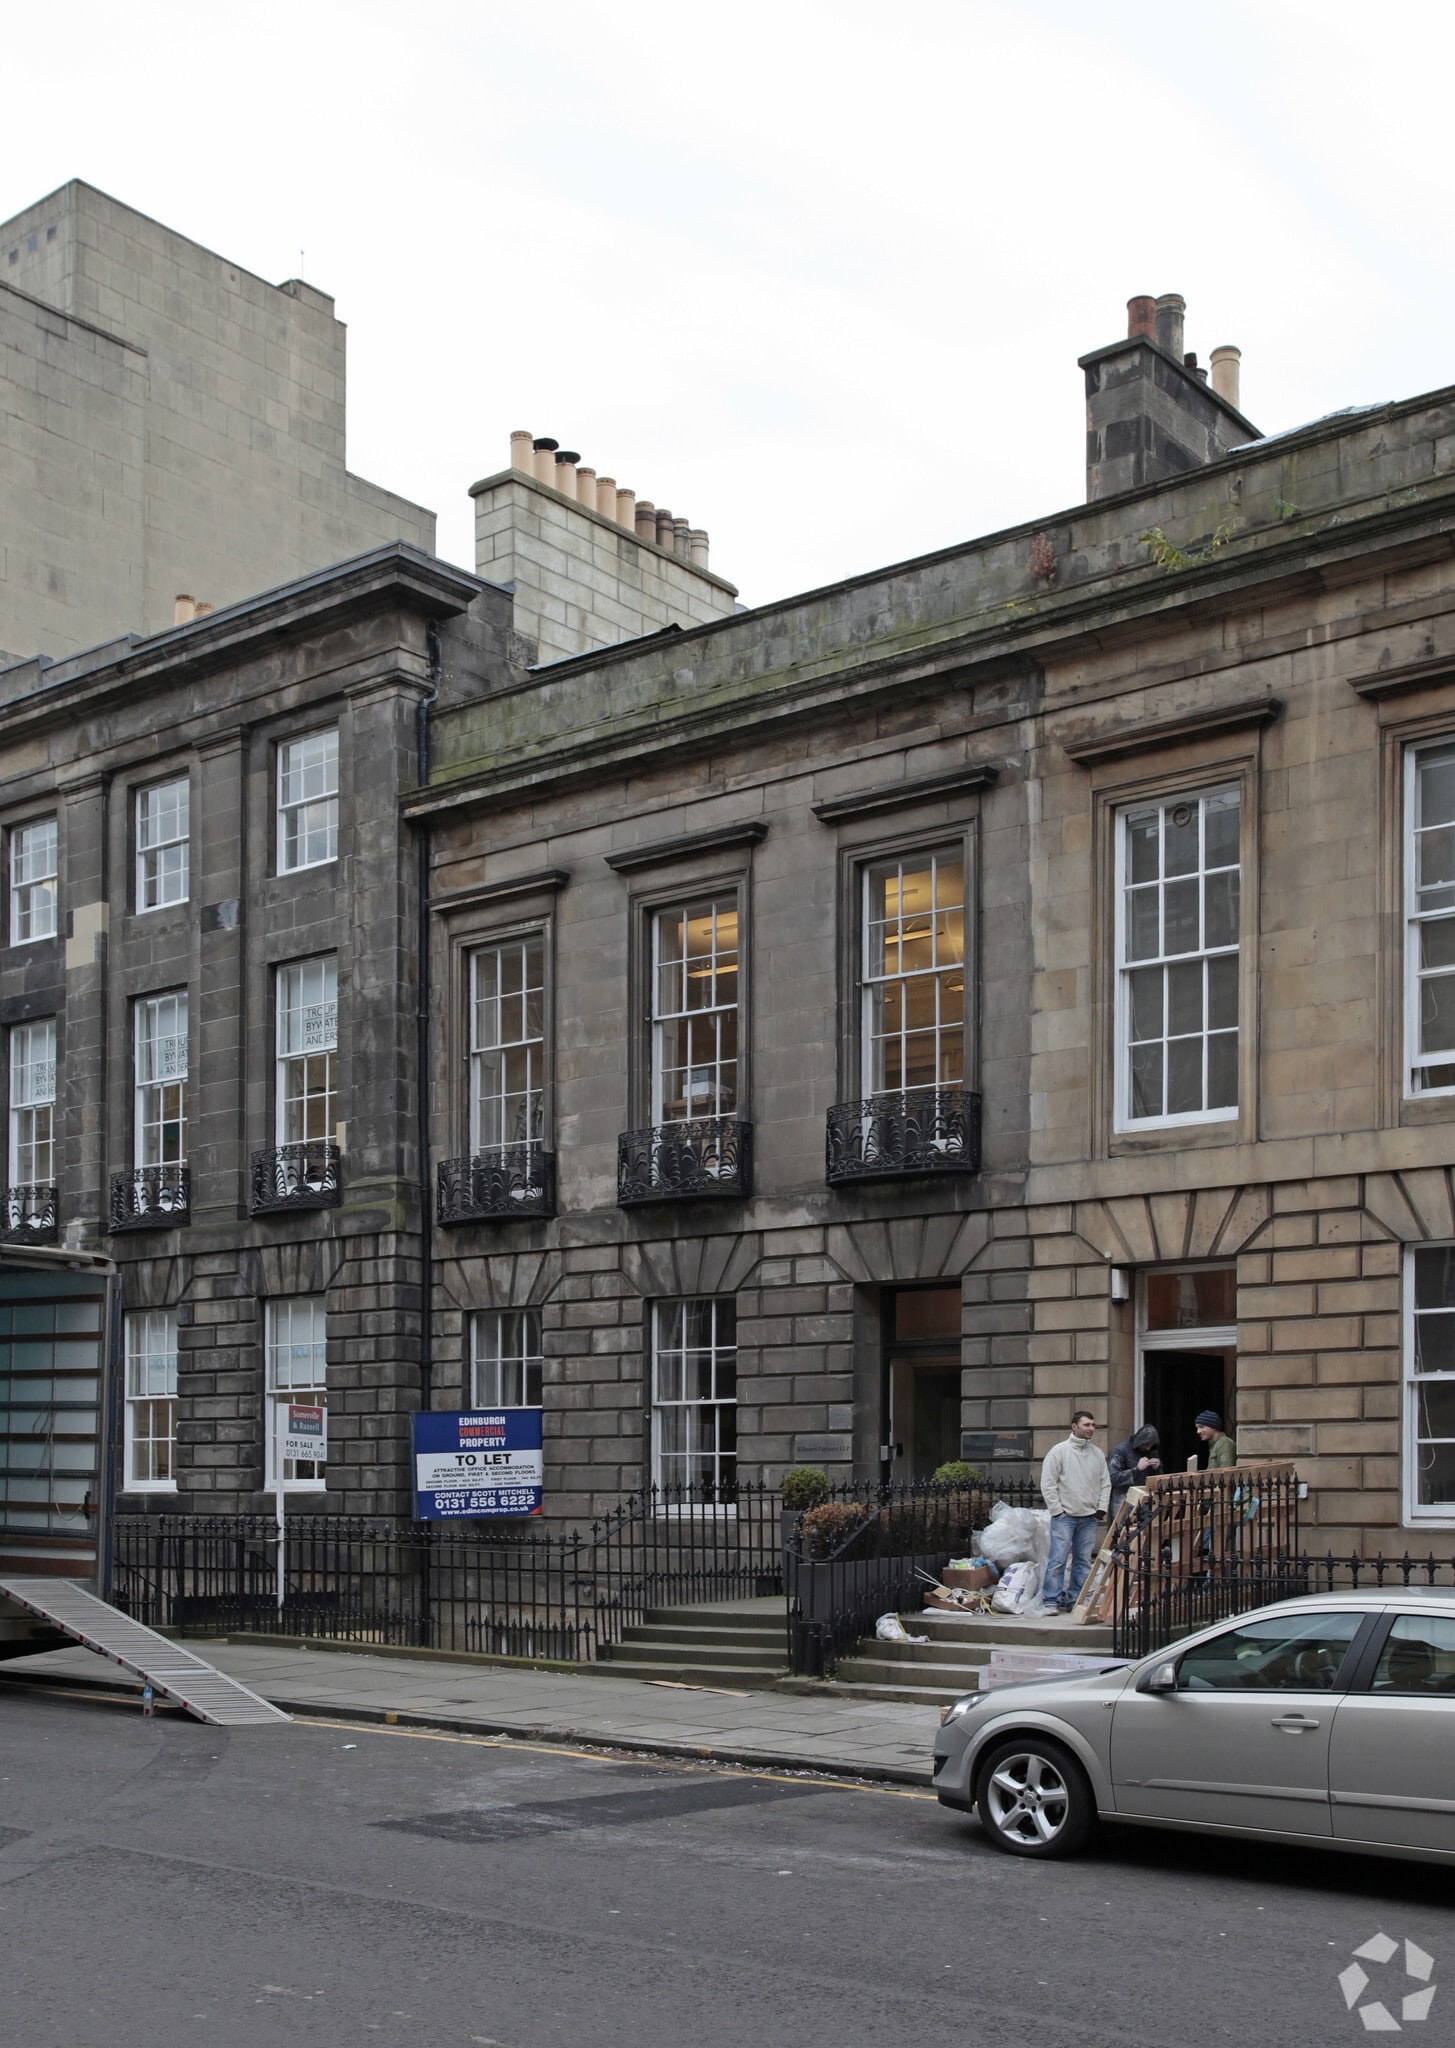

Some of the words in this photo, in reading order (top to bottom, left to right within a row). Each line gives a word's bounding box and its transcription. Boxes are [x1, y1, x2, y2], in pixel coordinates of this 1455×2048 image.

[293, 1410, 320, 1419] Somerville
[300, 1422, 319, 1430] Russell
[459, 1416, 506, 1426] EDINBURGH
[459, 1426, 505, 1437] COMMERCIAL
[460, 1437, 506, 1447] PROPERTY
[456, 1455, 476, 1466] TO
[484, 1454, 512, 1465] LET
[435, 1499, 465, 1509] 0131
[470, 1497, 496, 1507] 556
[500, 1495, 535, 1506] 6222
[441, 1505, 528, 1515] www.edincomprop.co.uk
